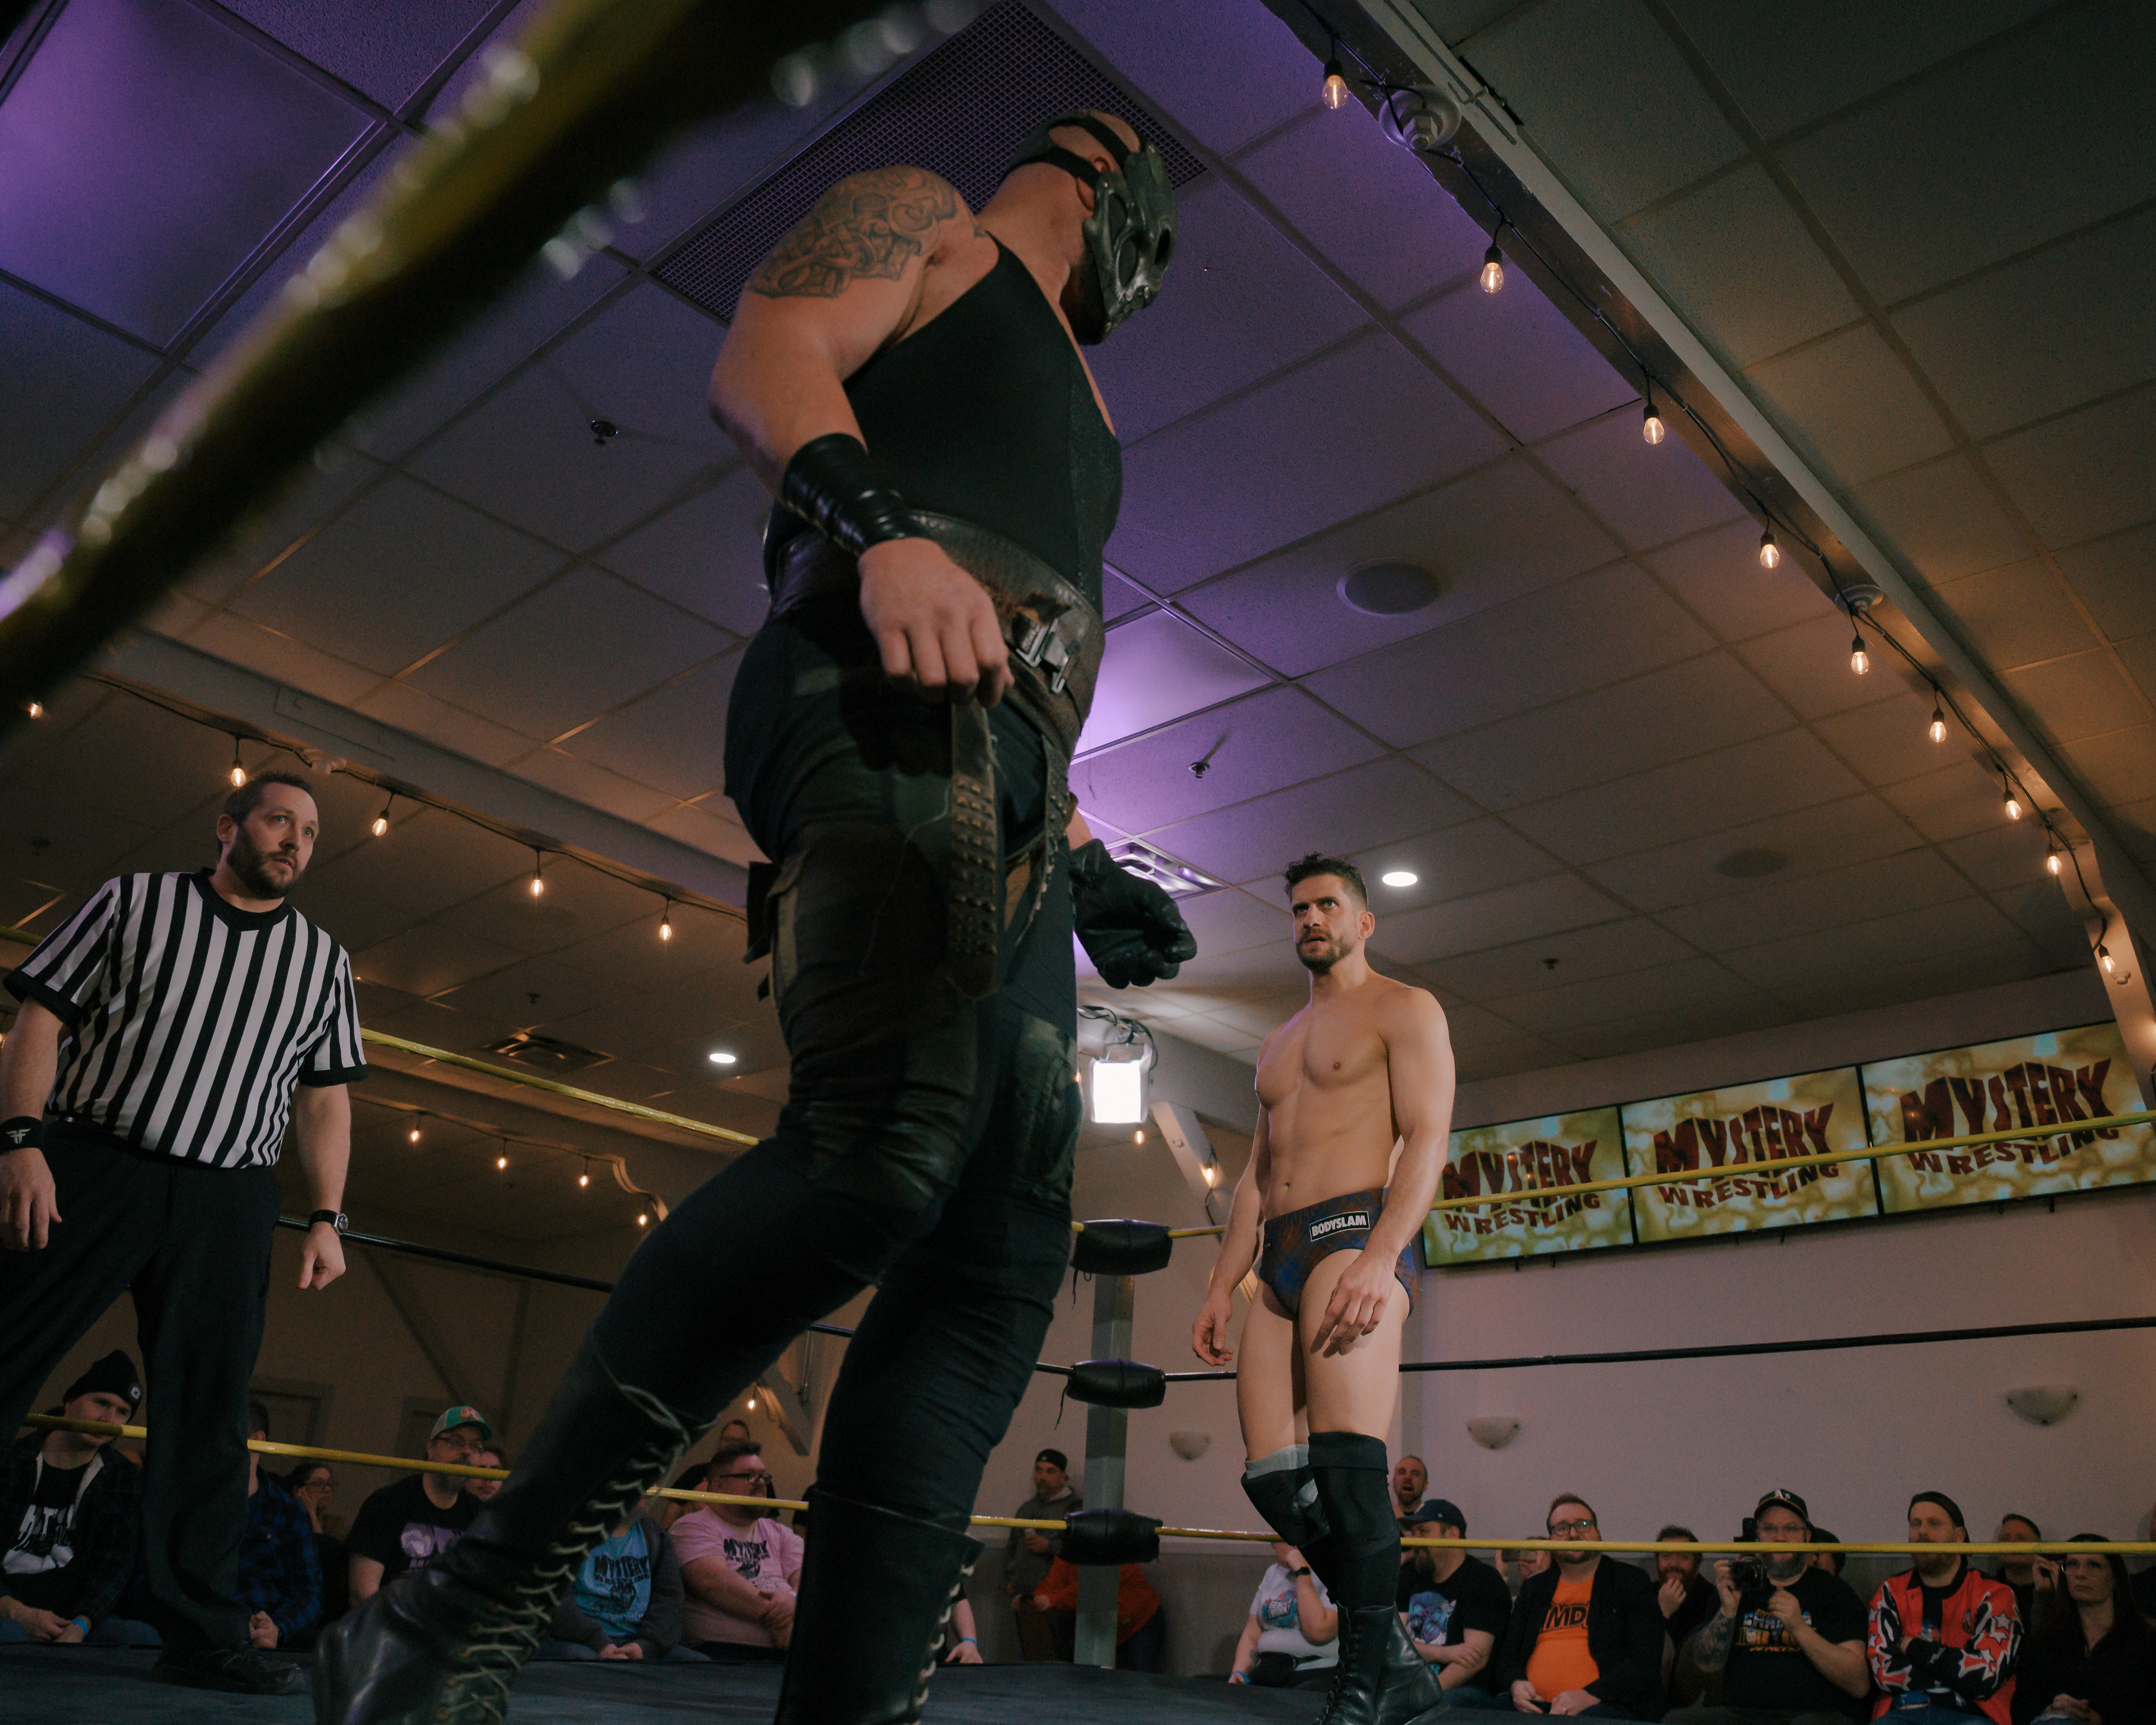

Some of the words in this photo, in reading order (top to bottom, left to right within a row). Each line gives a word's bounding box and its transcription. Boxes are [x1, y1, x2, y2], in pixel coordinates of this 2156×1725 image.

[1900, 1058, 2114, 1151] MYSTERY
[1653, 1103, 1834, 1186] MYSTERY
[1907, 1128, 2120, 1175] WRESTLING
[1442, 1140, 1597, 1213] MYSTERY
[1659, 1163, 1839, 1208] WRESTLING
[1312, 1215, 1367, 1237] BODYSLAM
[1445, 1193, 1600, 1234] WRESTLING
[594, 1554, 648, 1578] MYSTERY
[724, 1539, 768, 1559] MYSTERY
